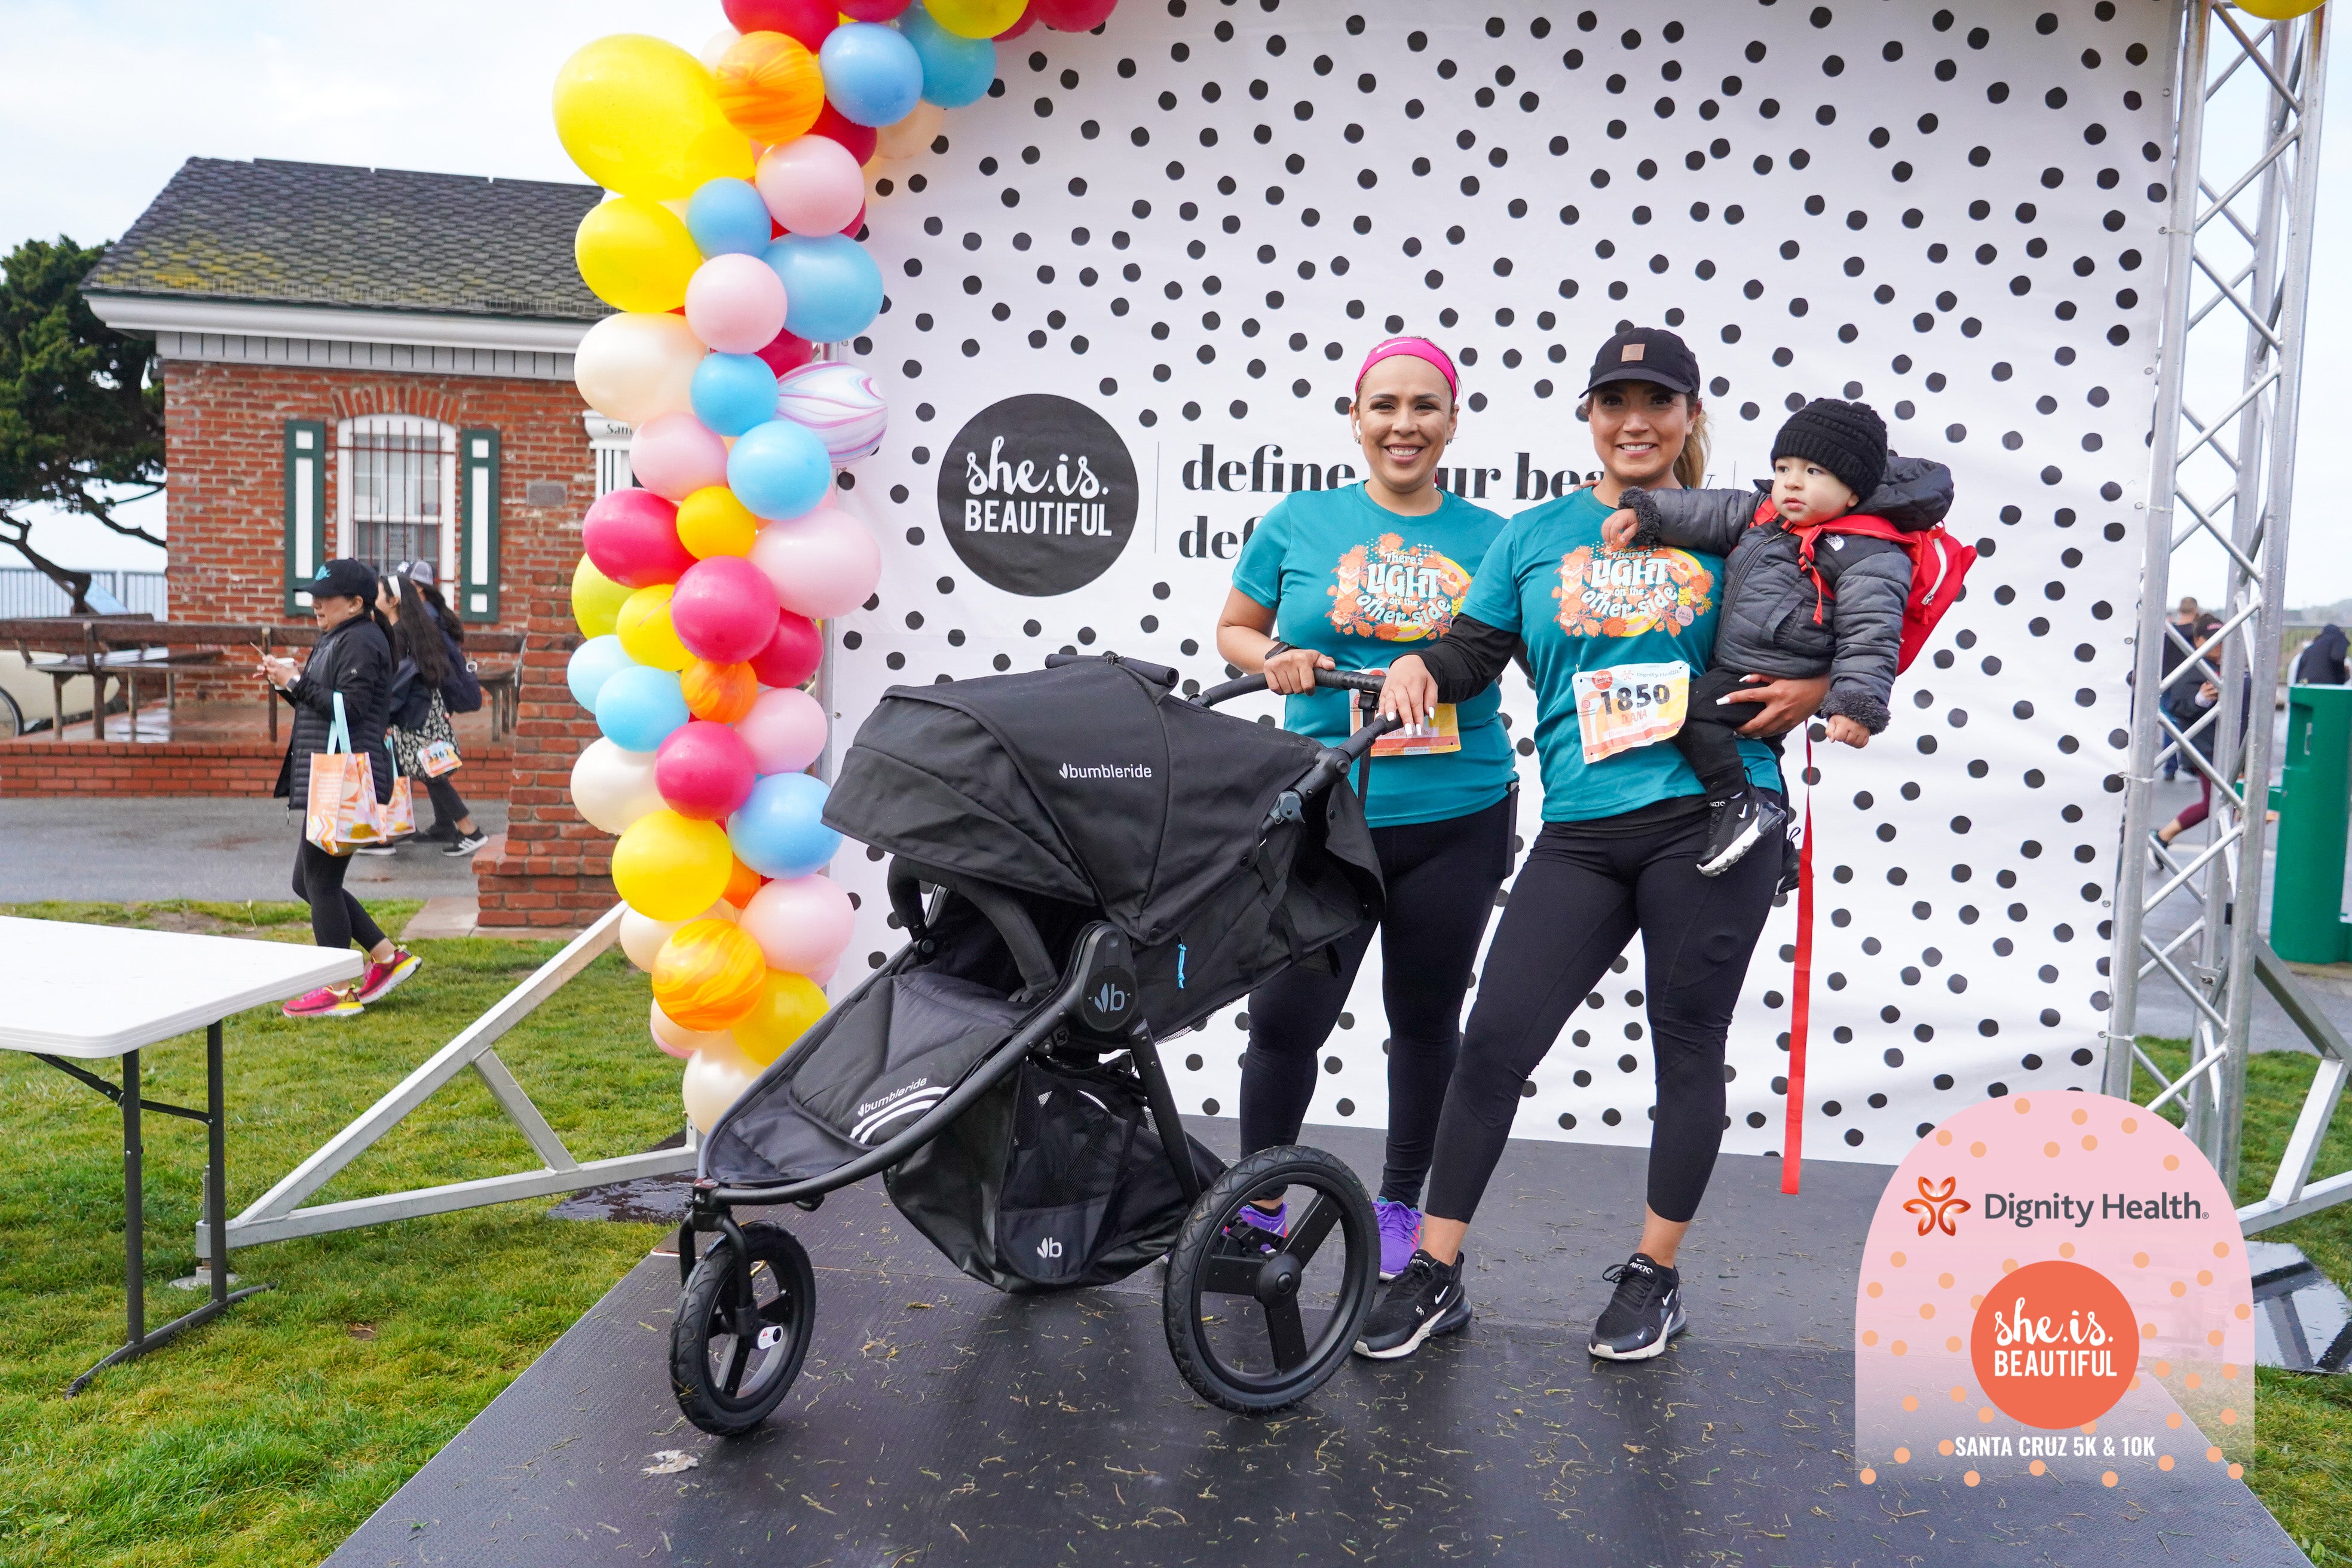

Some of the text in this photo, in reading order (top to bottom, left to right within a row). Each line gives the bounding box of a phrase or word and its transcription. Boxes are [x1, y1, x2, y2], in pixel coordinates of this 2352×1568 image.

[1182, 444, 1356, 493] define
[965, 499, 1112, 537] BEAUTIFUL
[1385, 552, 1423, 565] There's
[1612, 550, 1652, 559] There's
[1366, 563, 1441, 598] LIGHT
[1591, 559, 1671, 587] LIGHT
[1404, 598, 1419, 606] the
[1581, 587, 1678, 618] other side
[1615, 586, 1644, 597] on the
[1356, 595, 1451, 626] other side
[1601, 684, 1670, 715] 1850
[1622, 709, 1647, 724] DIANA
[1068, 764, 1152, 778] bumbleride
[1110, 984, 1125, 1011] b
[864, 1077, 927, 1114] bumbleride
[1049, 1237, 1062, 1258] b
